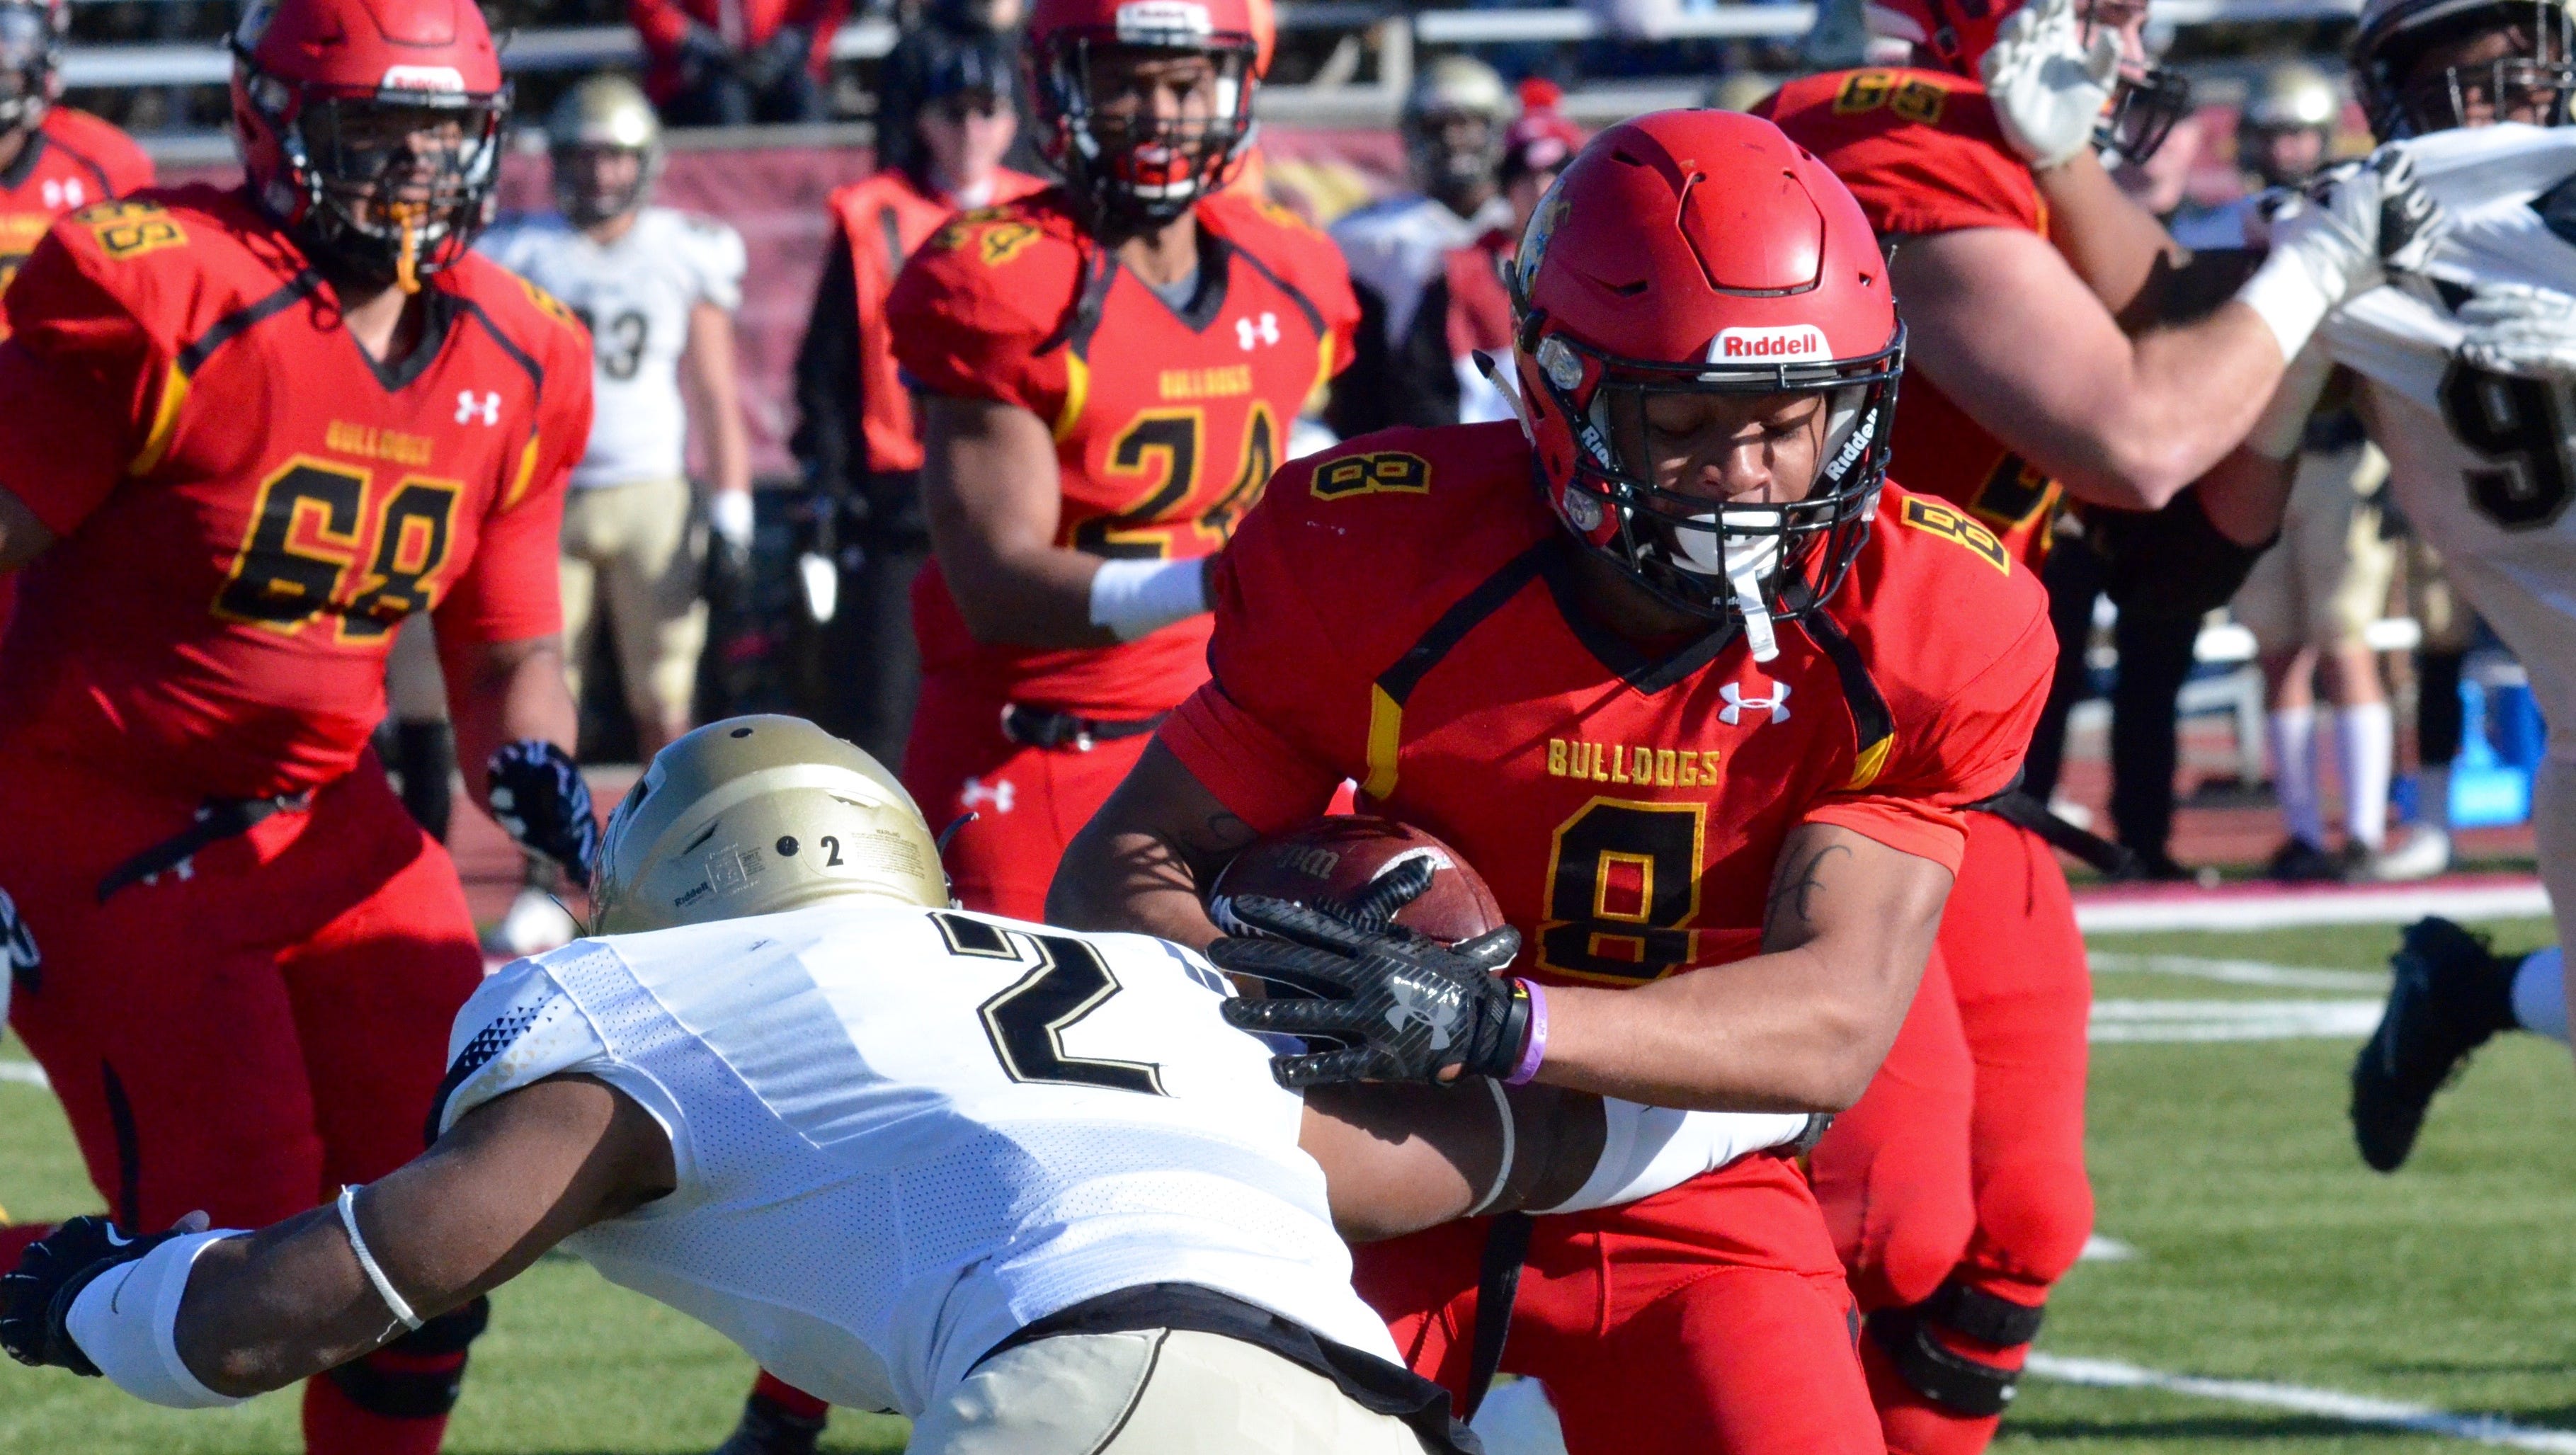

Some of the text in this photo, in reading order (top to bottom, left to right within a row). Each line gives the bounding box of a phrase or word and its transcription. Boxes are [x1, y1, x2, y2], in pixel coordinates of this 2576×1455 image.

[1723, 333, 1817, 357] Riddell
[1310, 451, 1431, 501] 8
[210, 454, 465, 646] 68
[1901, 495, 2010, 577] 8
[1547, 738, 1721, 787] BULLDOGS
[820, 835, 844, 867] 2
[674, 881, 709, 908] Riddell
[1534, 795, 1707, 986] 8
[925, 911, 1181, 1099] 2
